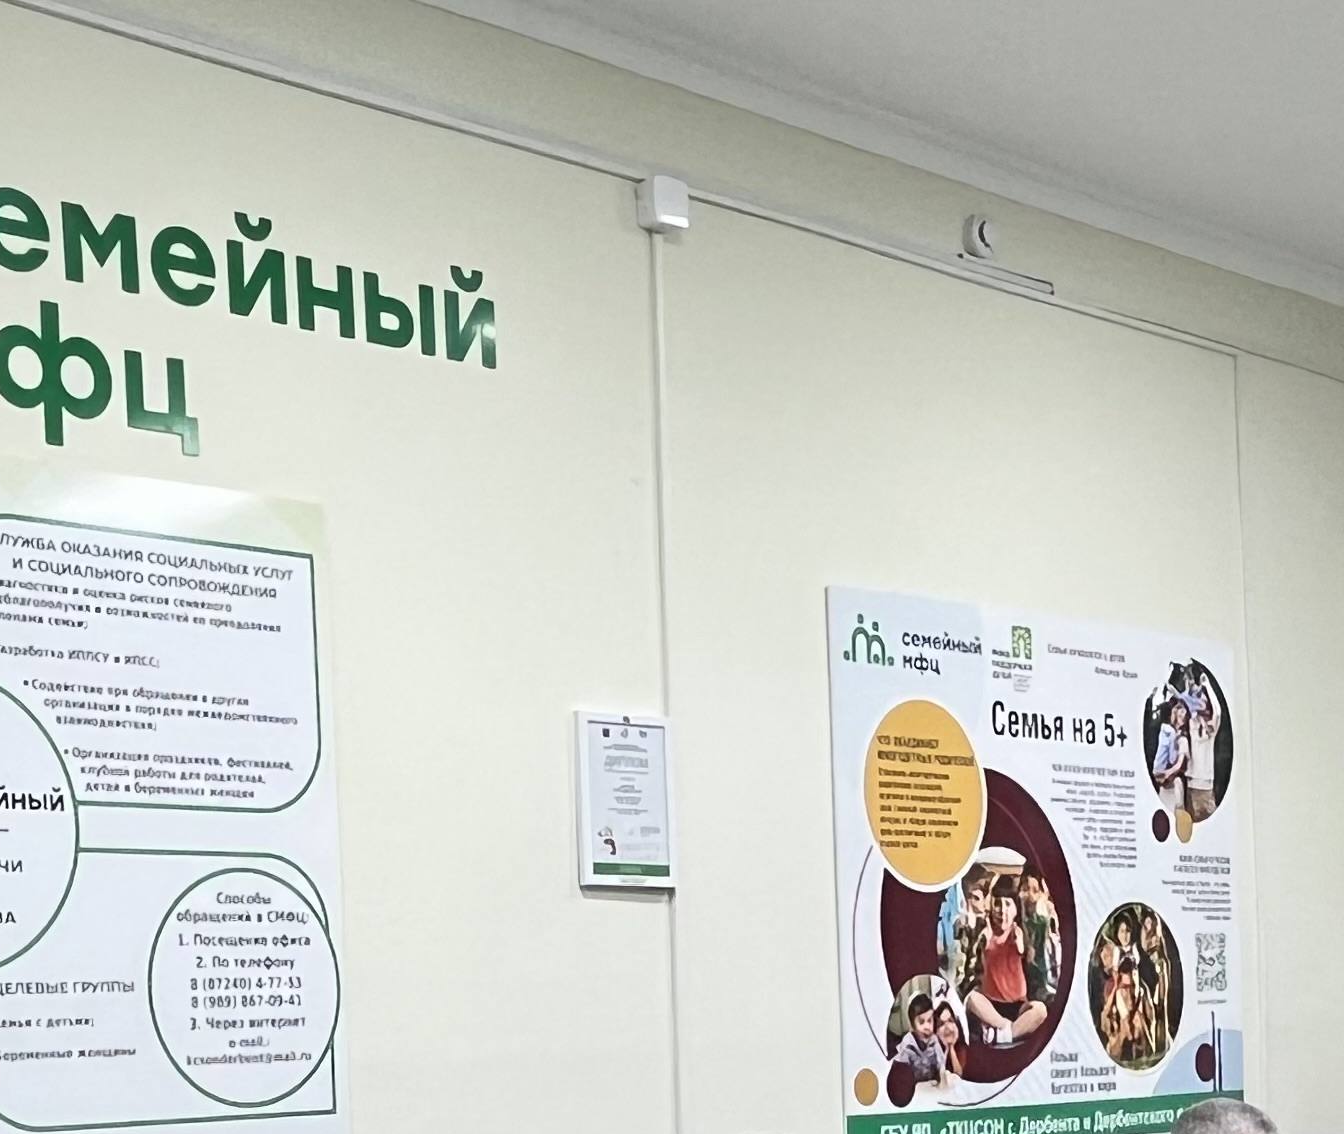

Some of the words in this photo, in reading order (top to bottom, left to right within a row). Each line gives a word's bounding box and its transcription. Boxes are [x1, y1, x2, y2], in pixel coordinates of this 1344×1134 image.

[60, 540, 144, 563] ОКАЗАНИЯ
[147, 551, 250, 575] СОЦИАЛЬНЫХ
[252, 566, 294, 581] УСЛУГ
[12, 557, 23, 570] И
[27, 559, 144, 584] СОЦИАЛЬНОГО
[147, 573, 277, 599] СОПРОВОЖДЕНИЯ
[901, 631, 982, 656] семейный
[902, 652, 941, 676] мфц
[991, 700, 1064, 742] Семья
[1072, 717, 1096, 745] на
[1104, 713, 1128, 748] 5+
[72, 980, 135, 994] ГРУППЫ
